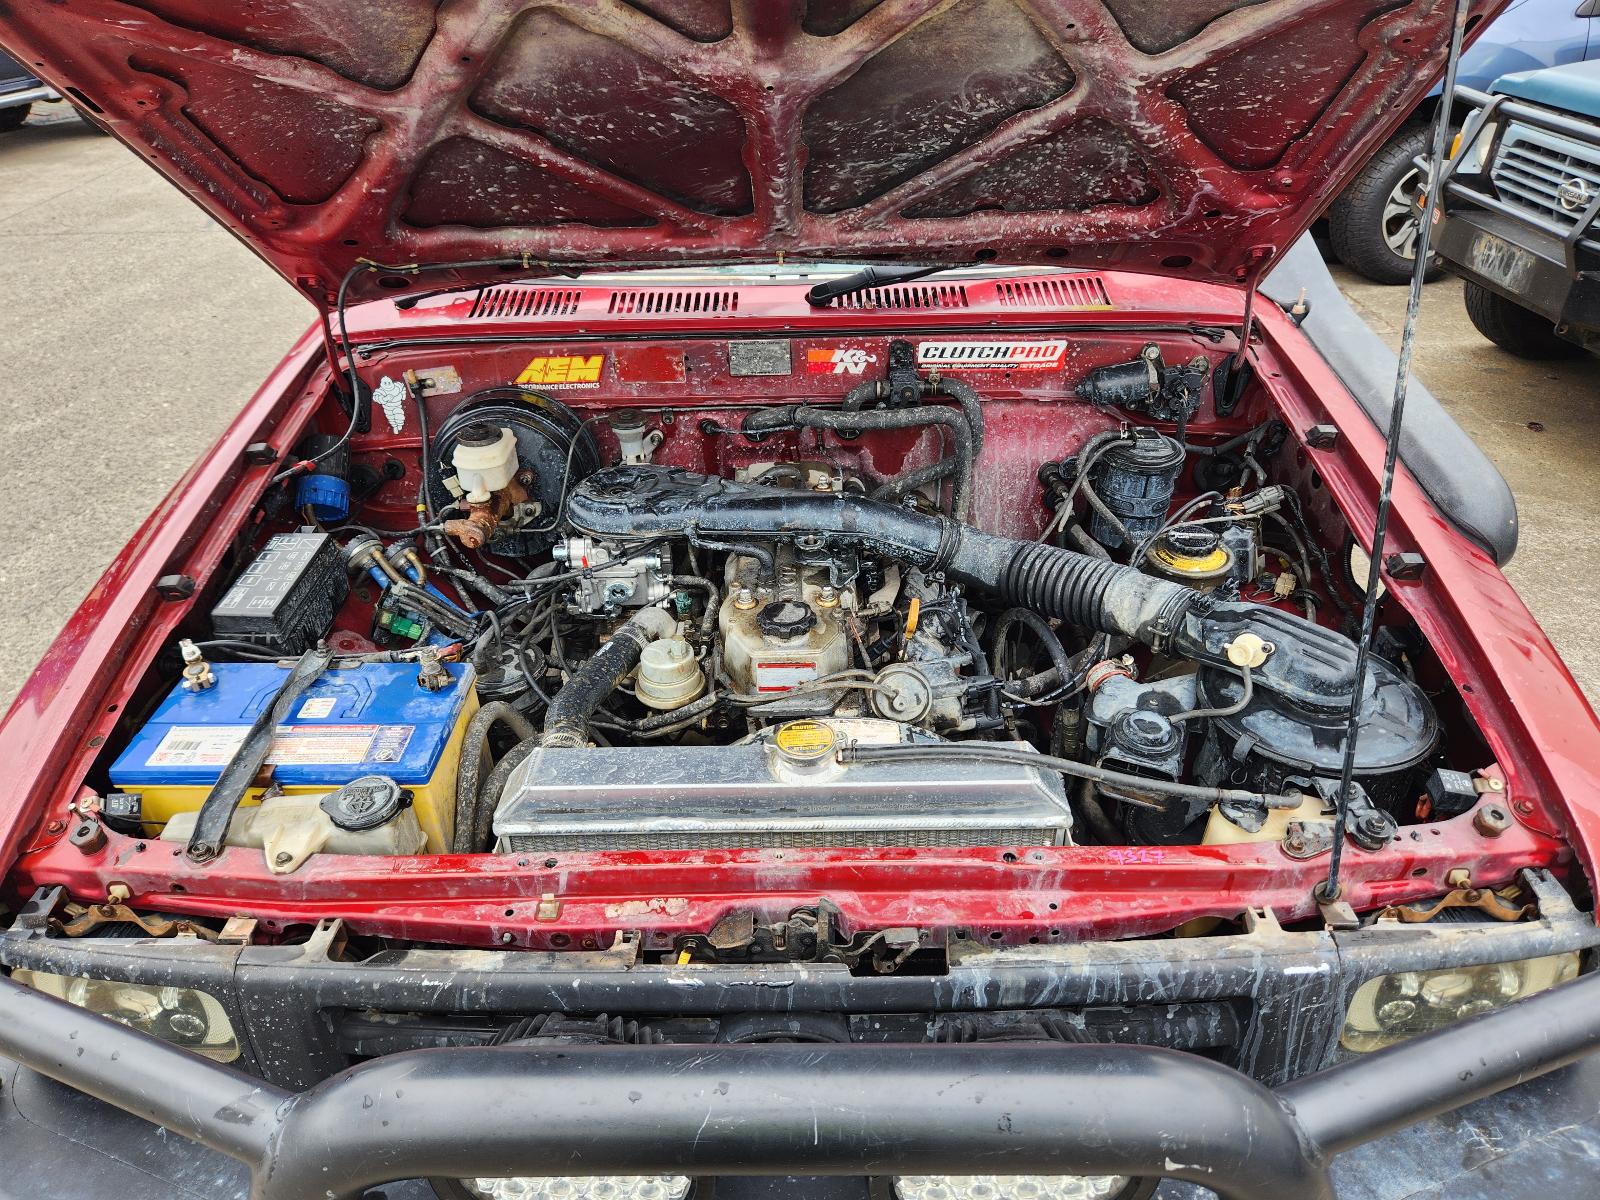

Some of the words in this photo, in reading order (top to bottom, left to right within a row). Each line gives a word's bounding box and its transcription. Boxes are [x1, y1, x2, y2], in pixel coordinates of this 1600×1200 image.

[831, 349, 877, 374] K&N
[922, 345, 1059, 359] CLUTCHPRO
[513, 355, 604, 383] AEM
[559, 382, 600, 390] ELECTRONICS
